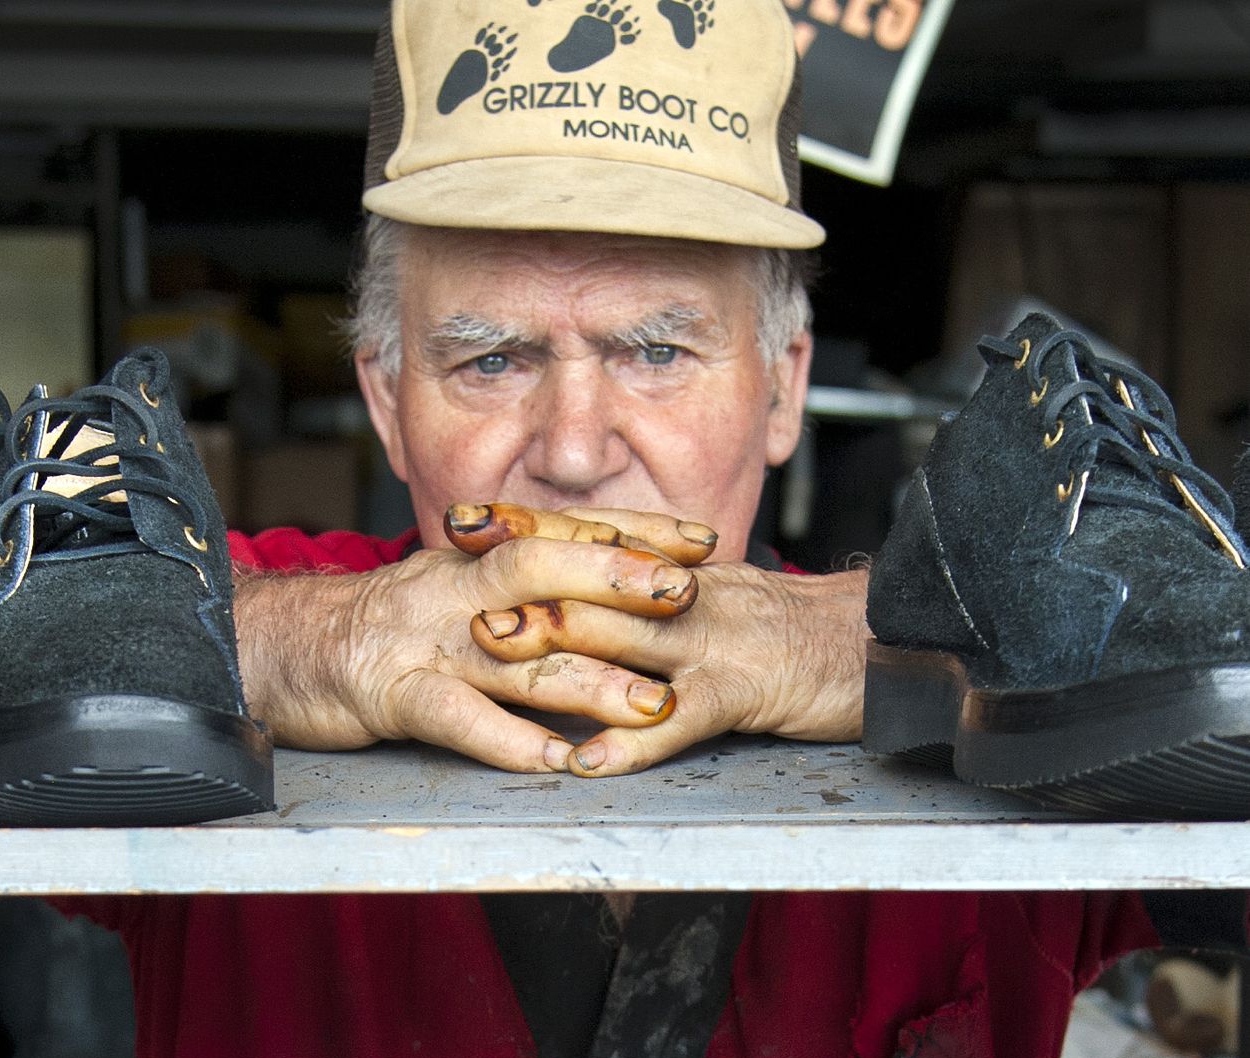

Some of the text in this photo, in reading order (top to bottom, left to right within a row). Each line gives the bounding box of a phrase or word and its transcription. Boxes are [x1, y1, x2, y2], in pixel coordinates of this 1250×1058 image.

[483, 82, 606, 114] GRIZZLY
[619, 85, 698, 124] BOOT
[563, 119, 694, 153] MONTANA
